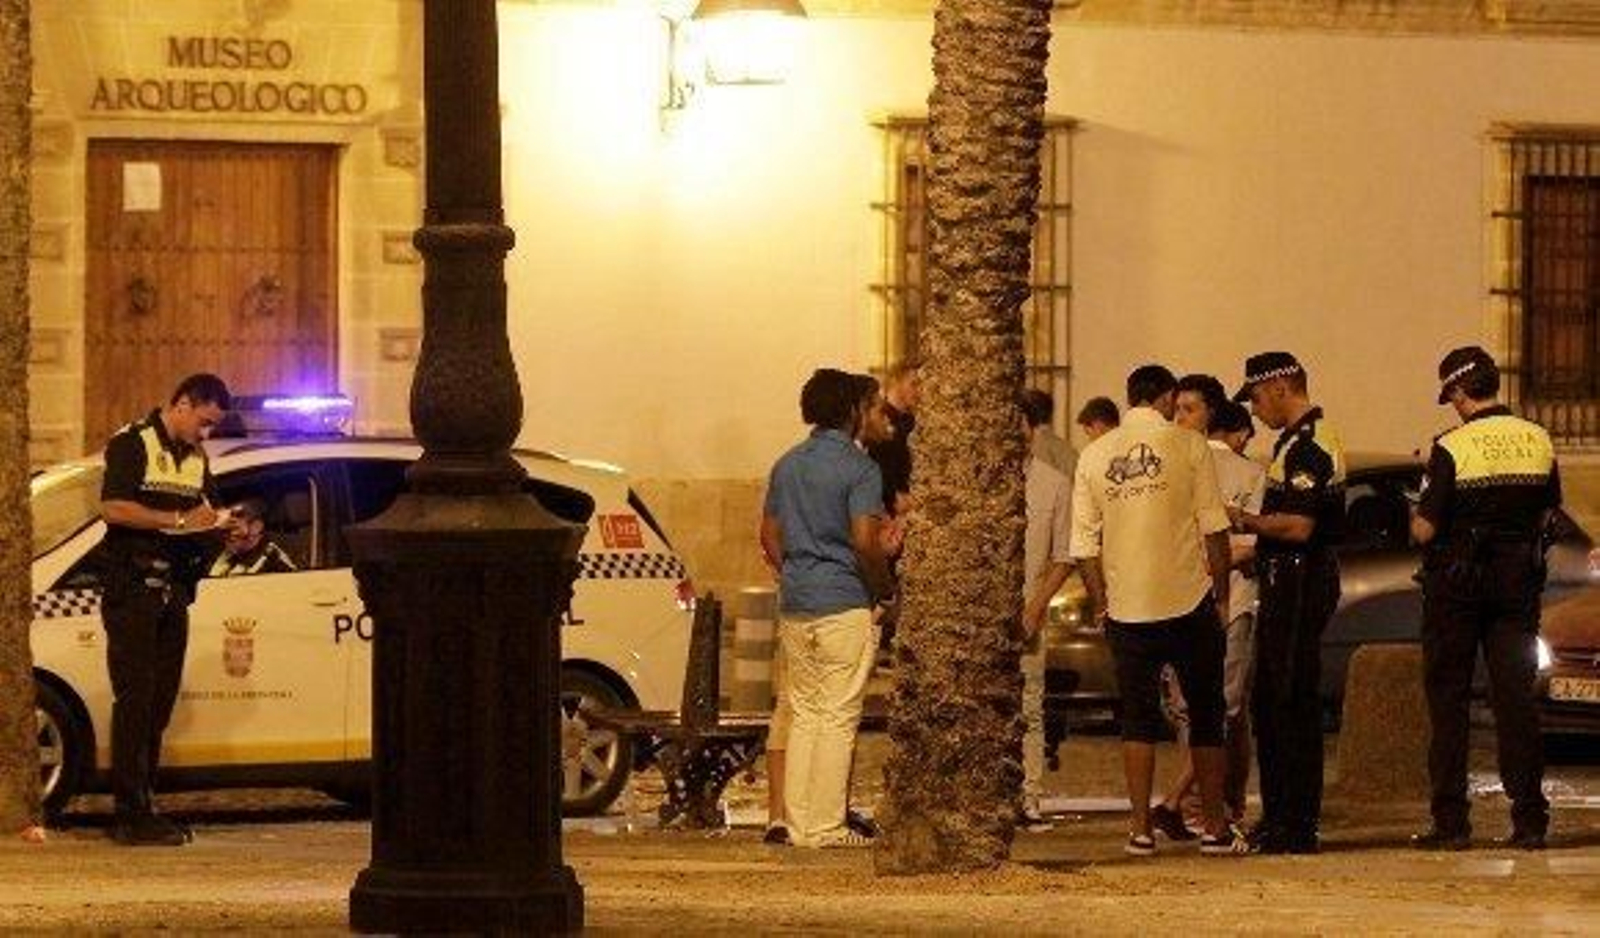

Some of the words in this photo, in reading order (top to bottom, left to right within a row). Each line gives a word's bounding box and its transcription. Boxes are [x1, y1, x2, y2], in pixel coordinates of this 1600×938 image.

[168, 36, 292, 70] MUSEO
[90, 77, 367, 115] ARQUEOLOGICO
[333, 613, 374, 644] PO
